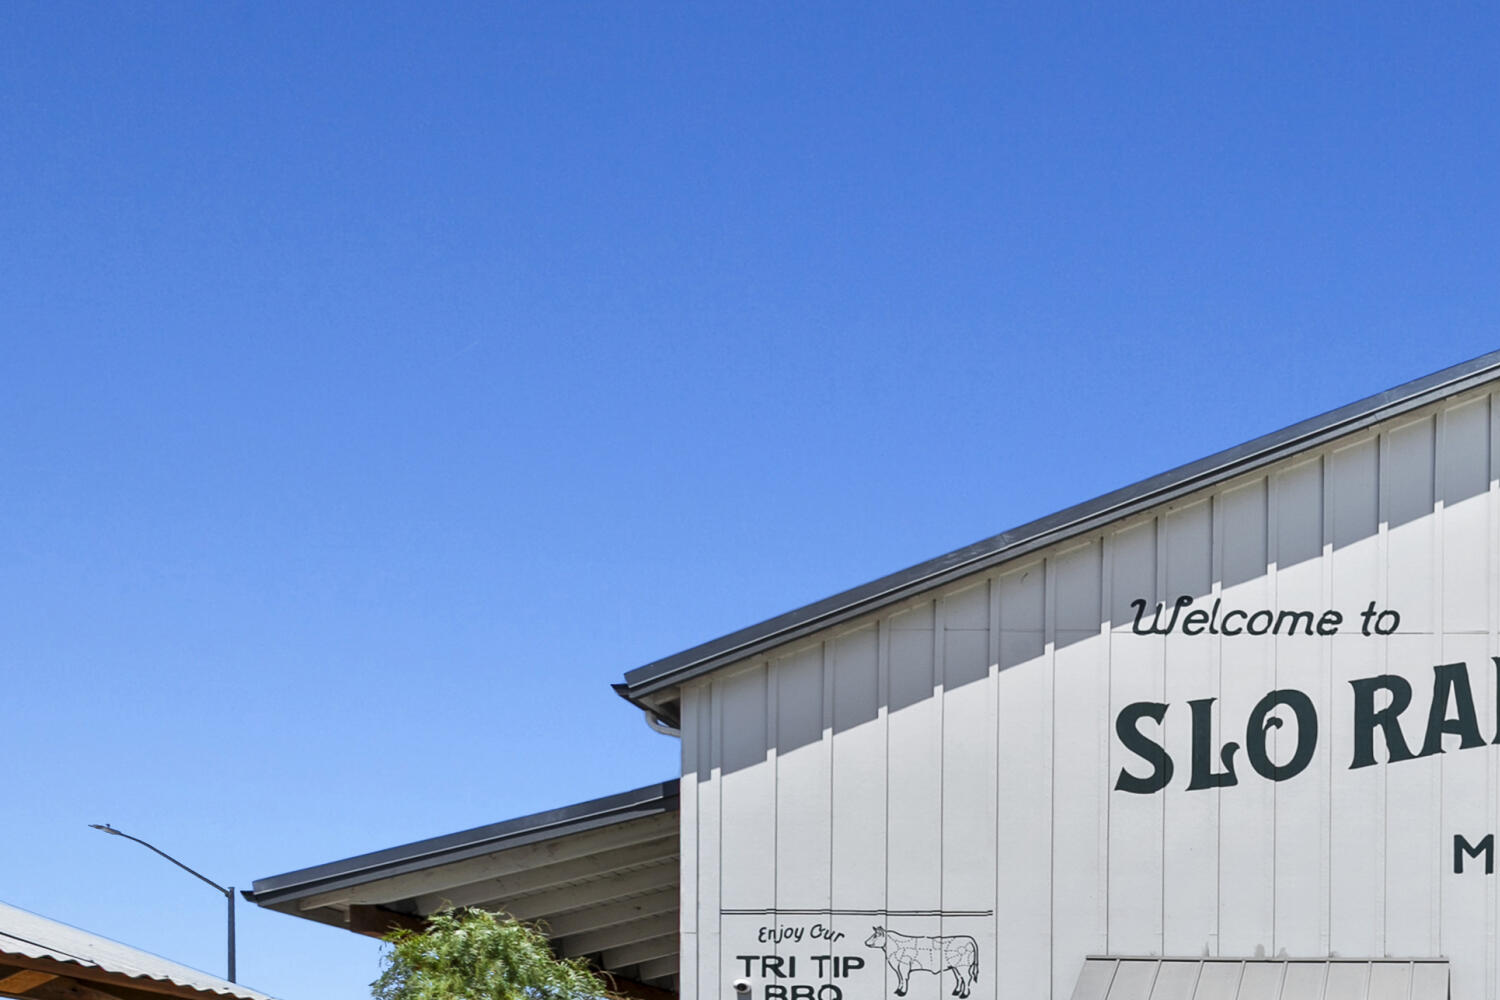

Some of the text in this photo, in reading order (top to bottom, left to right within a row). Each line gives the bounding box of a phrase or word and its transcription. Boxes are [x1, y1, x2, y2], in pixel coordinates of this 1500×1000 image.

[1131, 596, 1401, 636] Welcome to
[1114, 688, 1318, 794] SLO
[758, 924, 846, 943] Enjoy Our
[736, 955, 865, 978] TRI TIP
